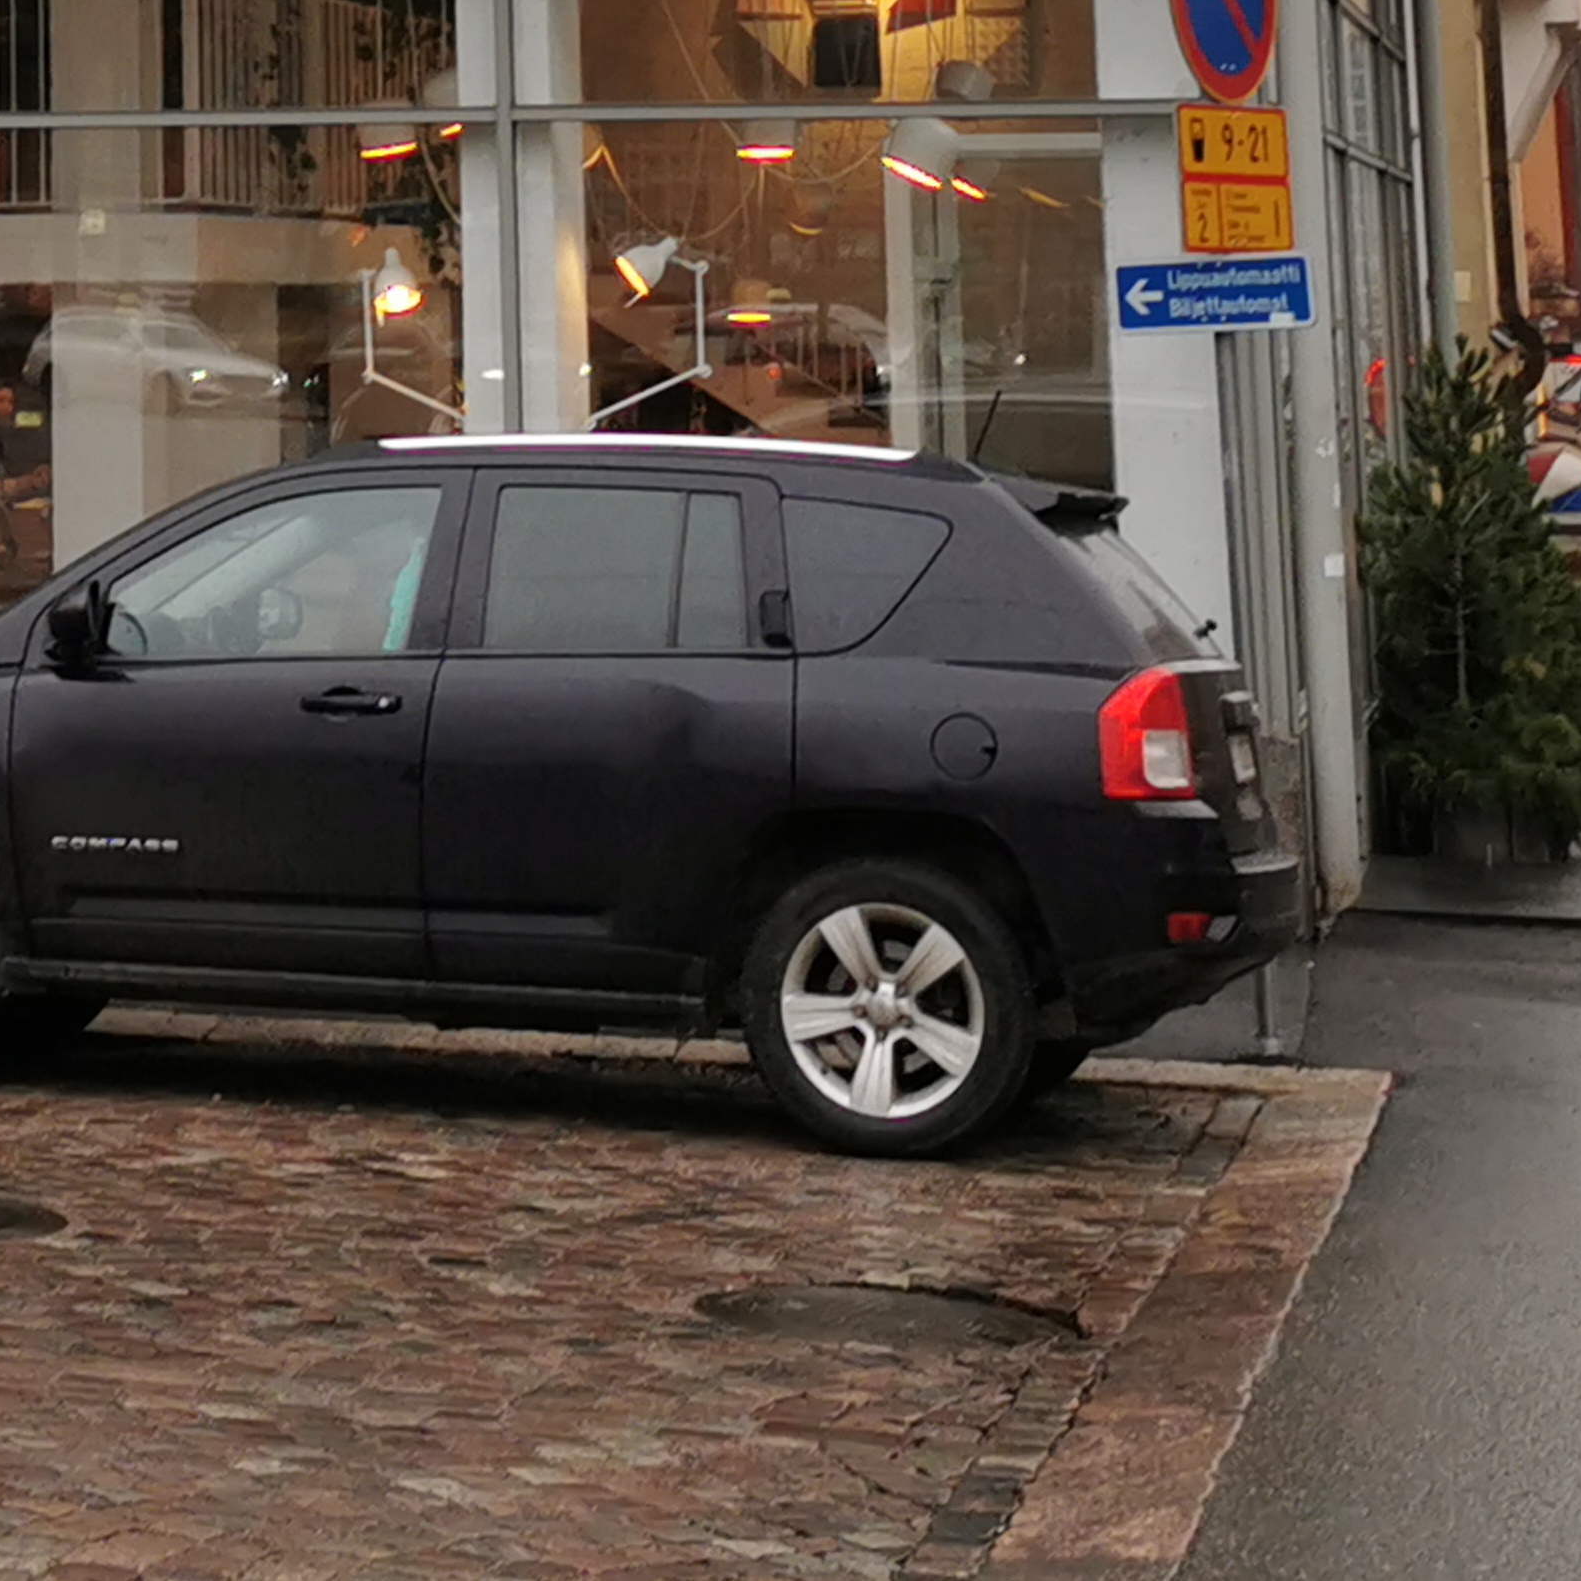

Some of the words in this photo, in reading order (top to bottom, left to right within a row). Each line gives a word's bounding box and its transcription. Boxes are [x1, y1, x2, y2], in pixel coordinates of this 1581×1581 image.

[1221, 123, 1270, 163] 9-21
[1197, 212, 1209, 244] 2
[1166, 263, 1301, 292] Lippuautomaatti
[51, 835, 180, 852] COMPASS
